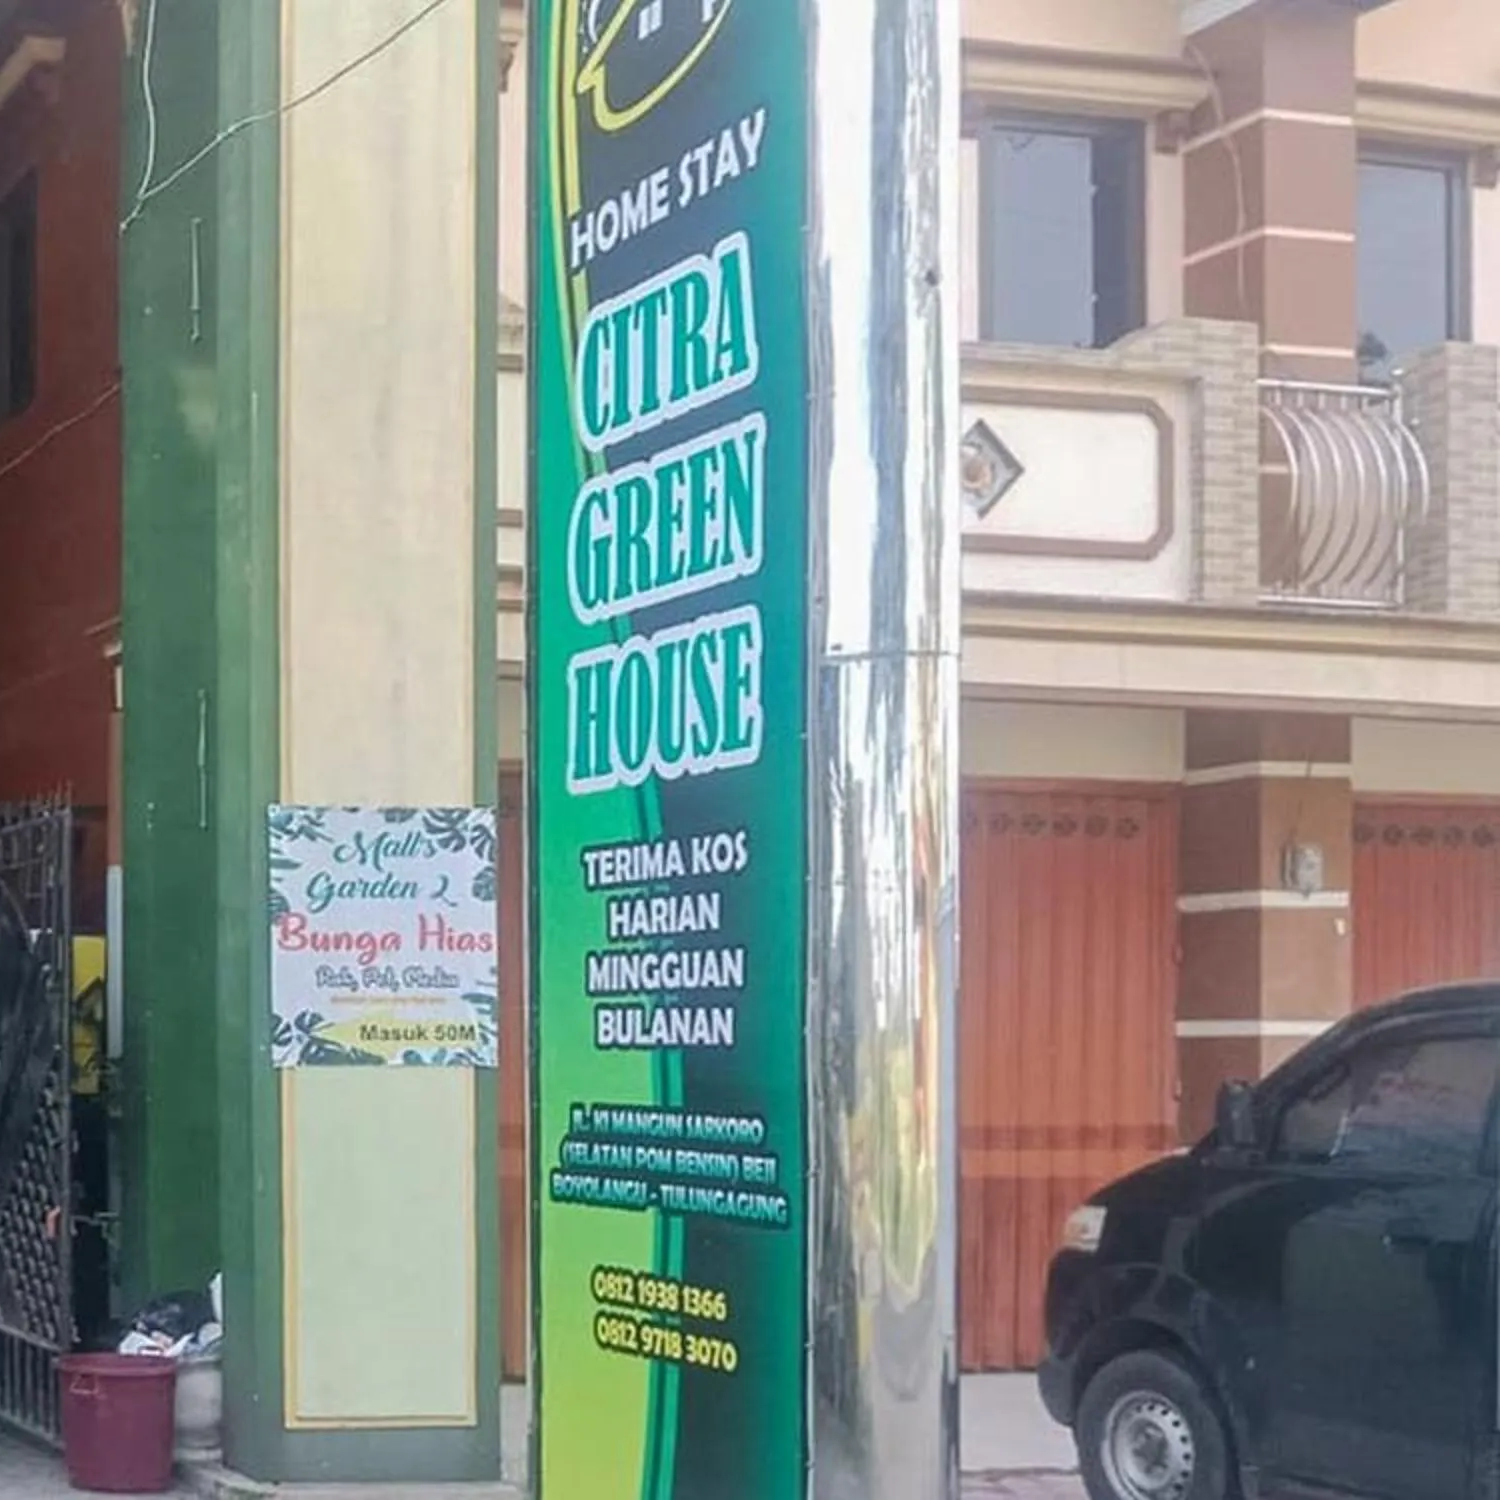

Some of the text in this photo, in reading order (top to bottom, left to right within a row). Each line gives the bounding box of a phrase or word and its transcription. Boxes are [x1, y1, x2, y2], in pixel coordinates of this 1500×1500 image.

[571, 109, 766, 268] HOME STAY
[580, 242, 754, 445] CITRA
[572, 425, 760, 615] GREEN
[571, 616, 758, 784] HOUSE
[584, 831, 748, 887] TERIMA KOS
[305, 871, 459, 914] Garden 2
[609, 892, 720, 937] HARIAN
[277, 912, 495, 965] Bunga Hias
[587, 949, 744, 992] MINGGUAN
[358, 1023, 476, 1042] Masuk 50M
[598, 1007, 734, 1045] BULANAN
[611, 1110, 683, 1138] MANGUN
[635, 1146, 672, 1174] POM
[552, 1173, 648, 1205] BOYOLANGU
[659, 1184, 787, 1224] TULUNGAGUNG
[594, 1271, 727, 1321] 0812 1938 1366
[597, 1317, 738, 1372] 0812 9718 3070
